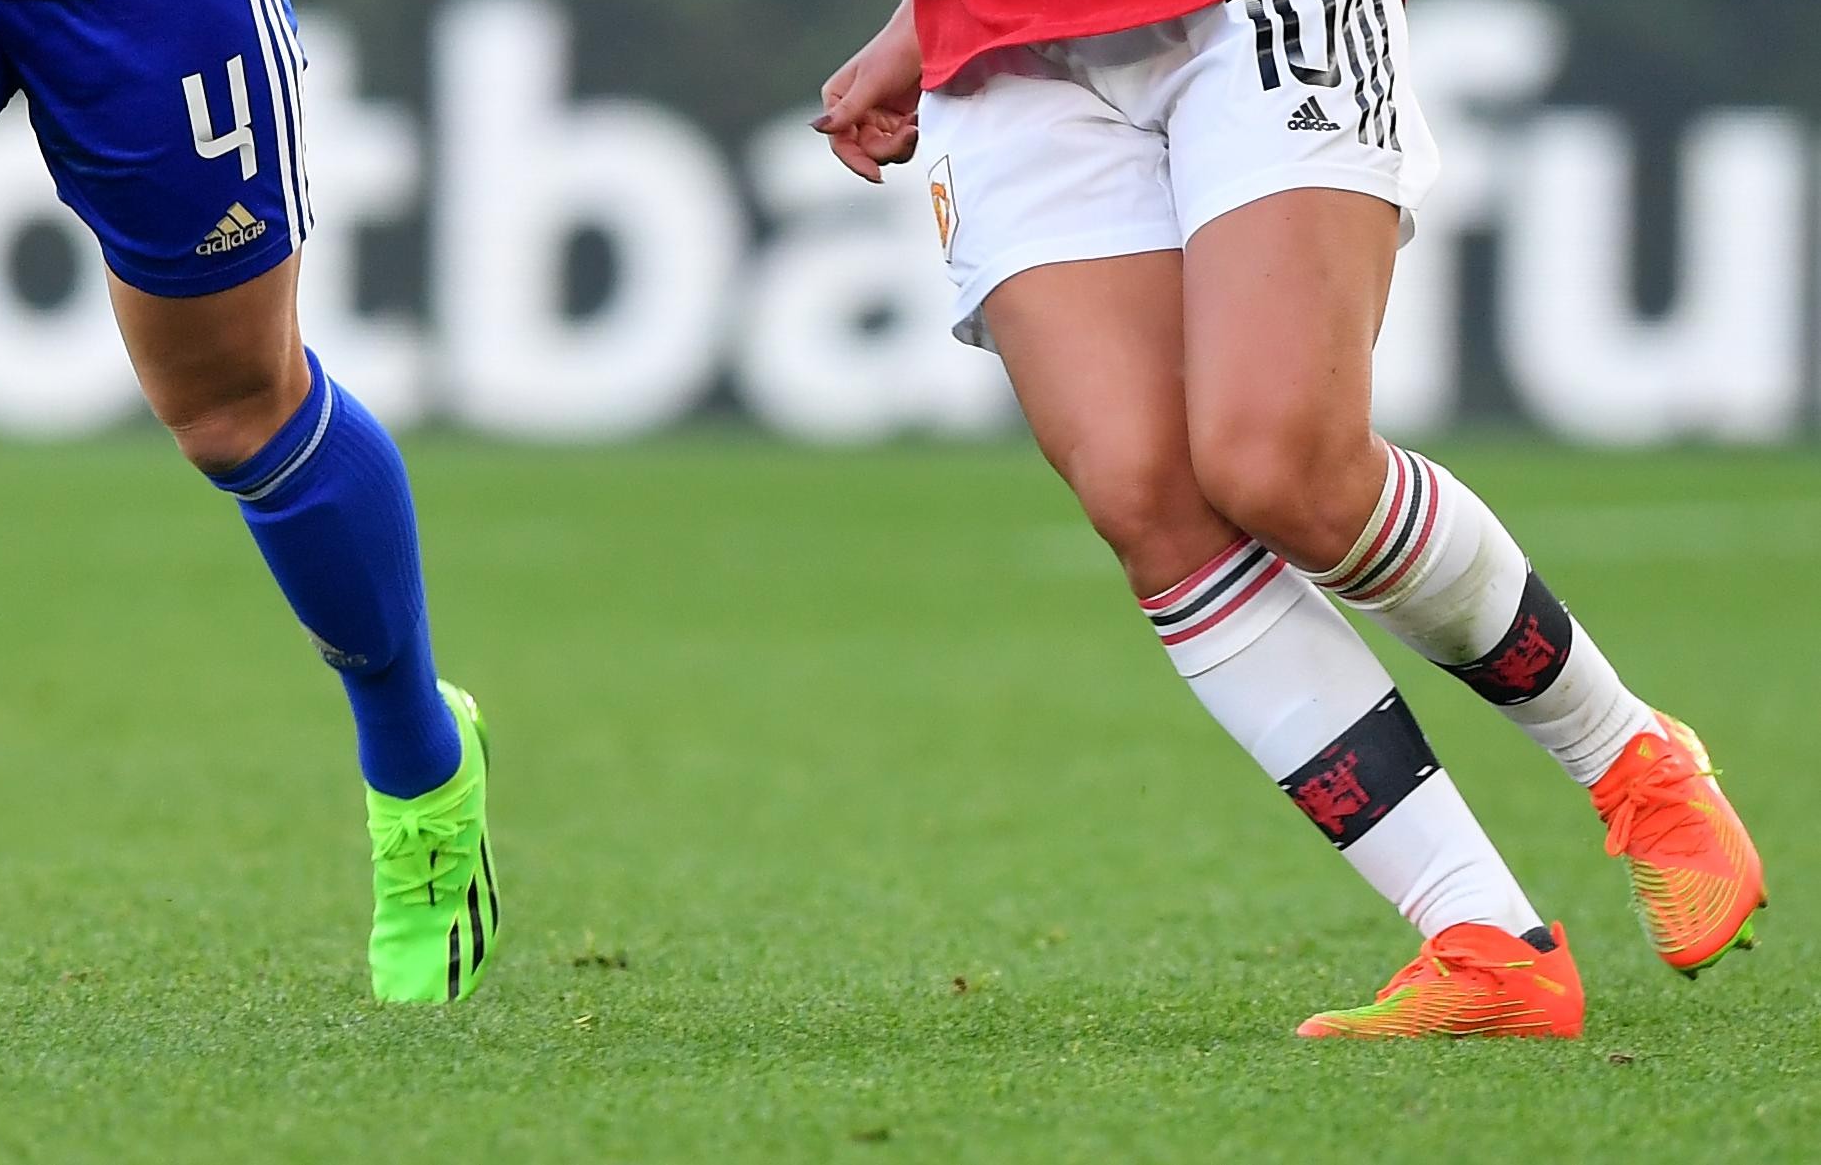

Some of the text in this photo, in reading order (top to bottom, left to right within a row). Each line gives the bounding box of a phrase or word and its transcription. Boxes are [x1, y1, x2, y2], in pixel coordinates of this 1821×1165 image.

[181, 53, 258, 182] 4
[1287, 119, 1342, 132] adidas
[195, 219, 267, 256] adidas
